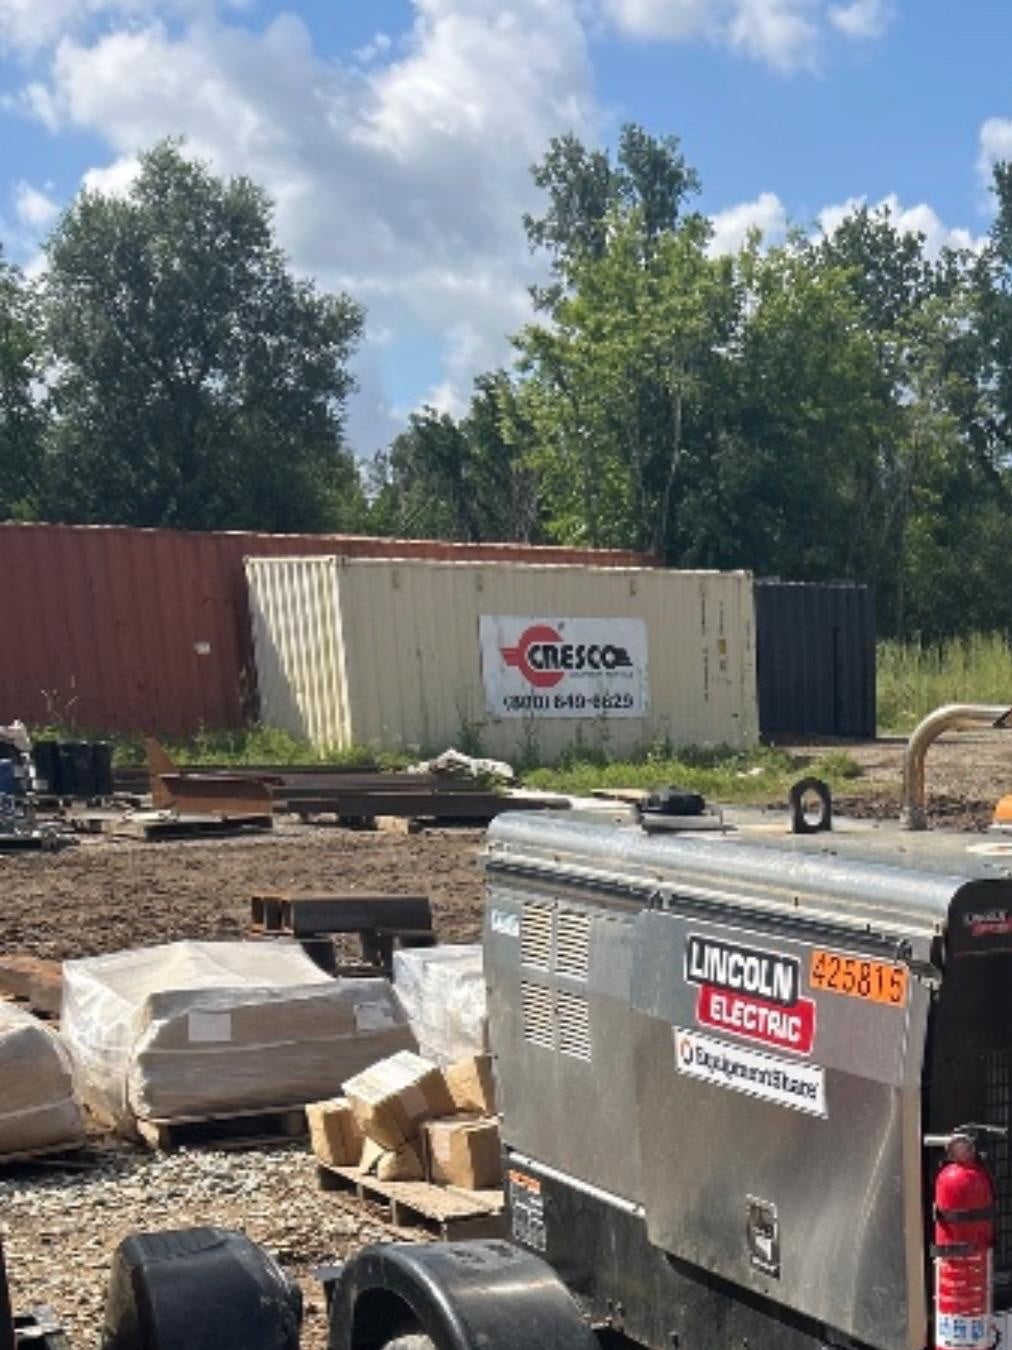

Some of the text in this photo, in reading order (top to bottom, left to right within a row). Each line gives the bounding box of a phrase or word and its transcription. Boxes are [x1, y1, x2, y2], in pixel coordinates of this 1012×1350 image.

[528, 644, 633, 670] CRESCO
[690, 941, 793, 1001] LINCOLN
[812, 952, 904, 1003] 425815
[710, 995, 802, 1043] ELECTRIC
